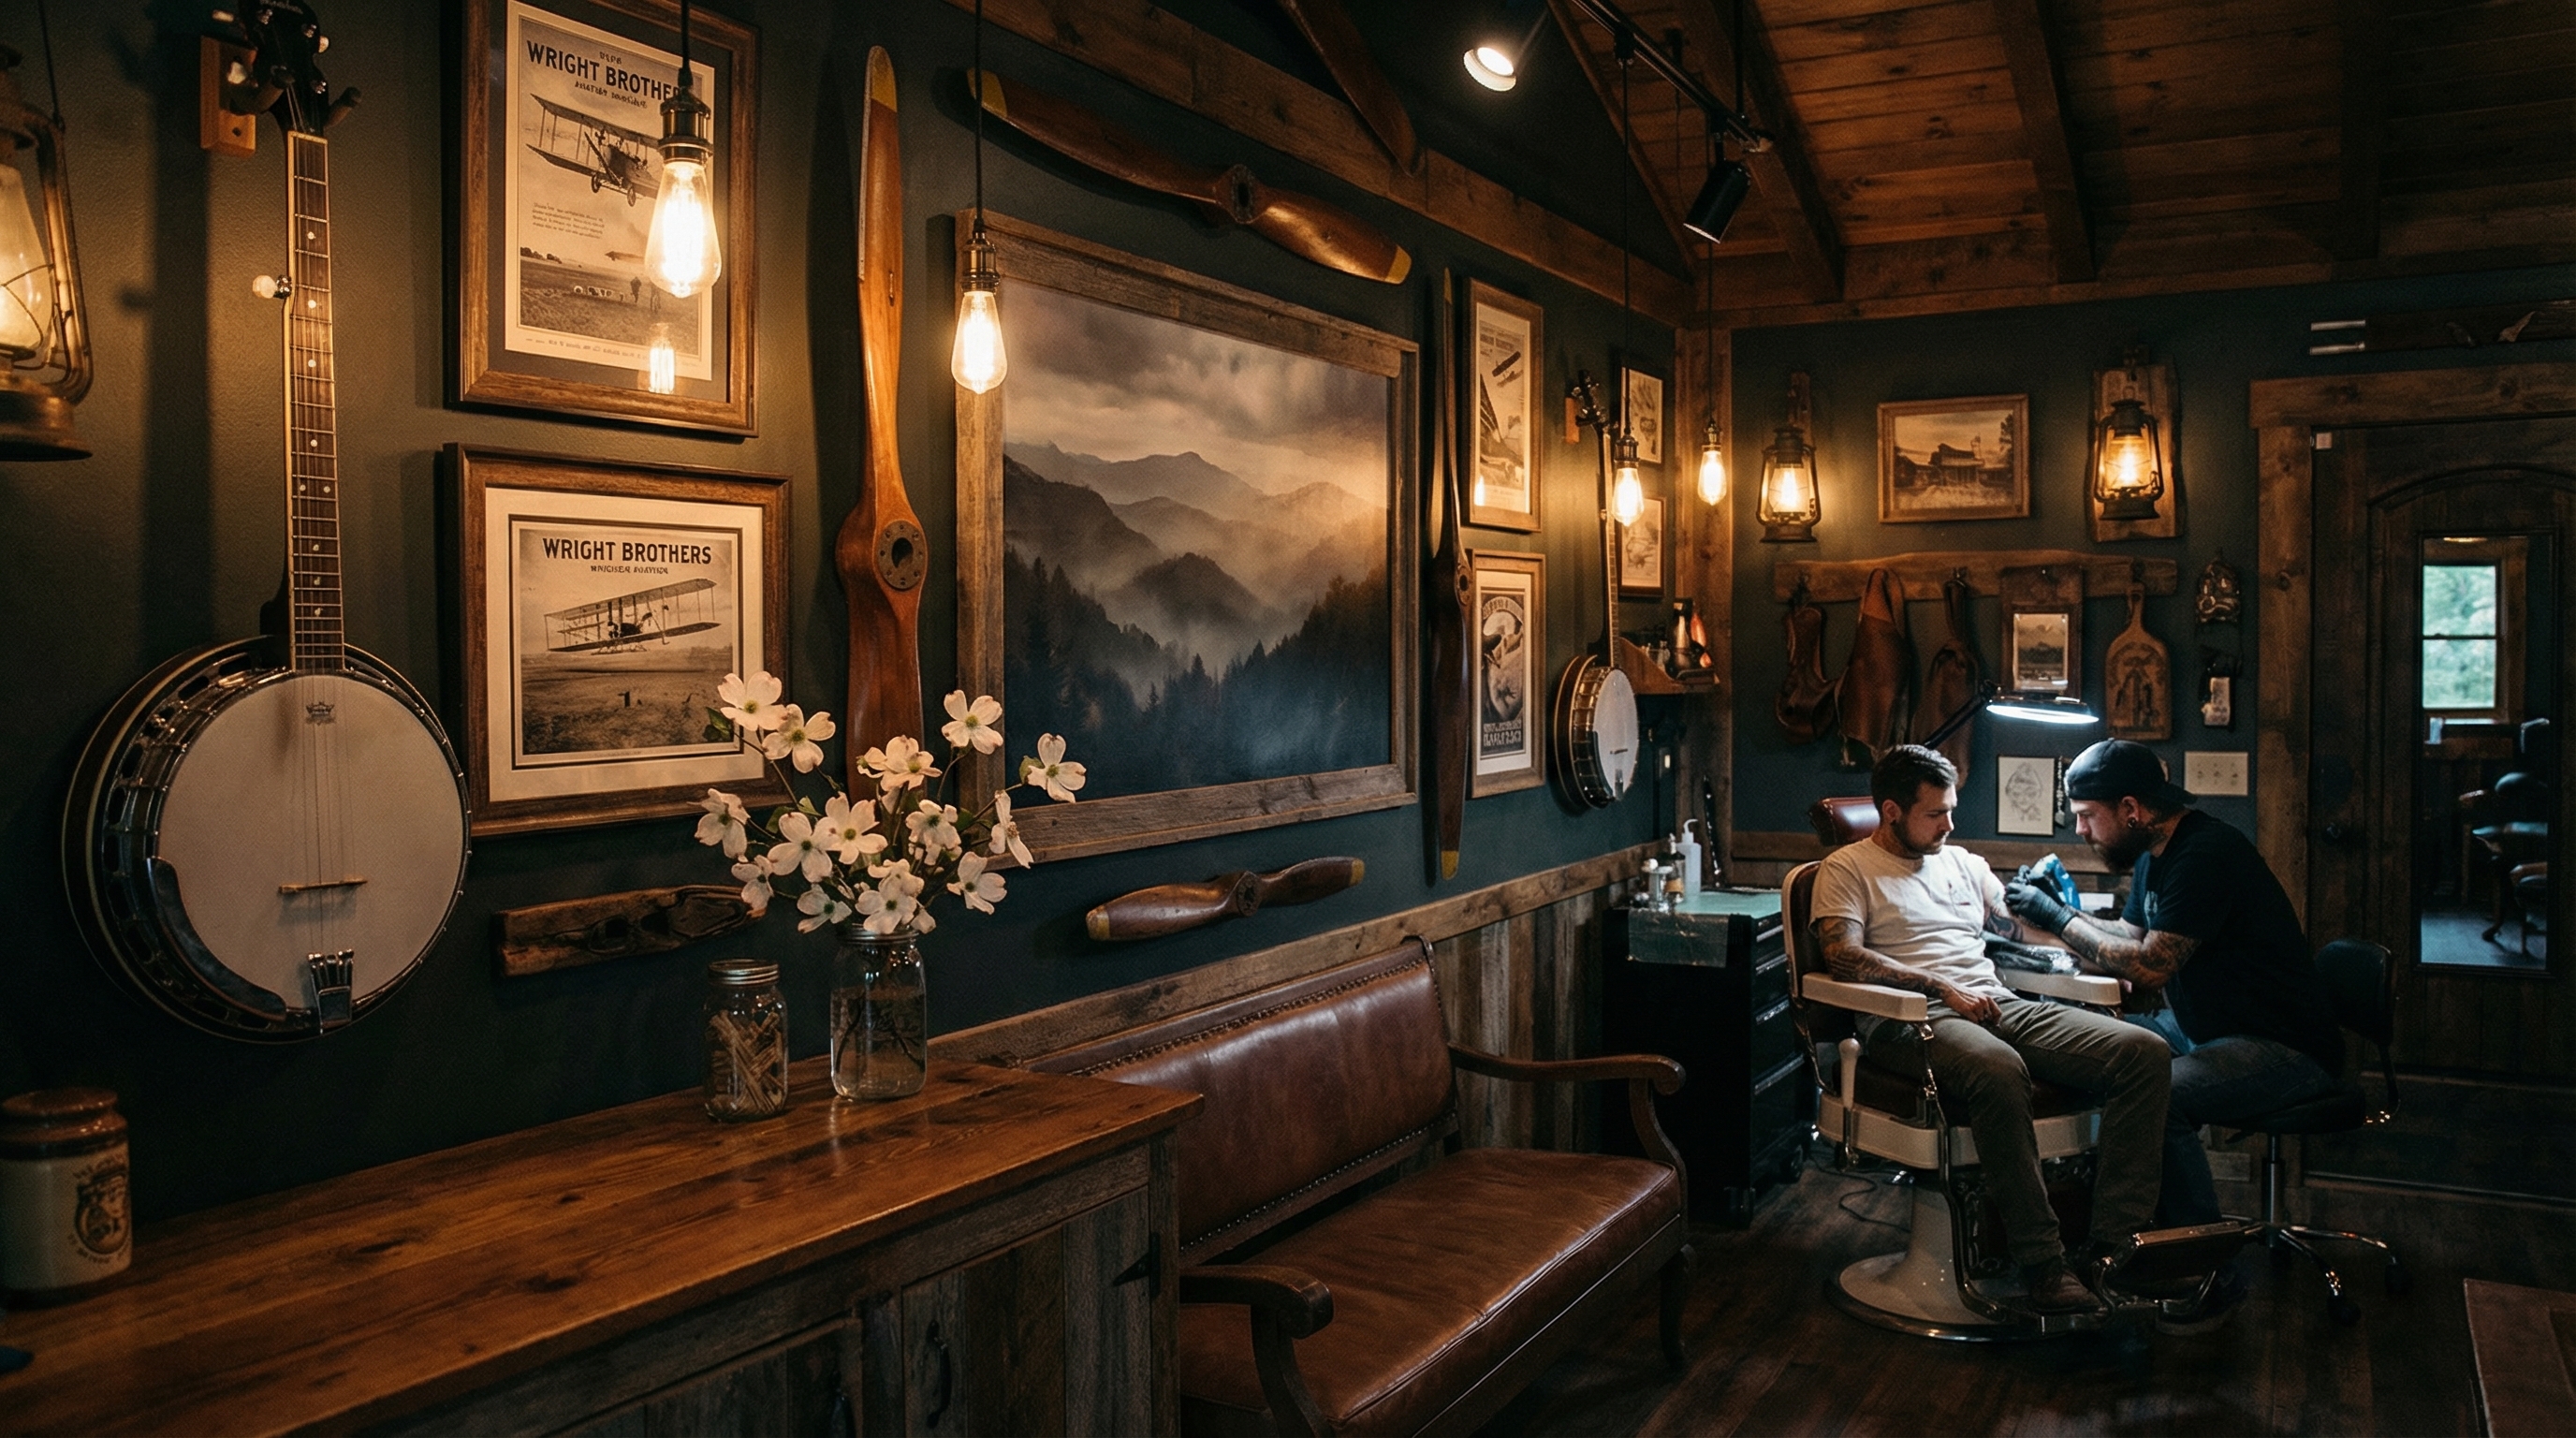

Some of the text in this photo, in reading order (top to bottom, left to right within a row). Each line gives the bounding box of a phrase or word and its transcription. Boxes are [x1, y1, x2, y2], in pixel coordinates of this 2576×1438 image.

[526, 40, 600, 81] WRIGHT
[606, 66, 681, 101] BROTHE
[542, 538, 711, 565] WRIGHT BROTHERS
